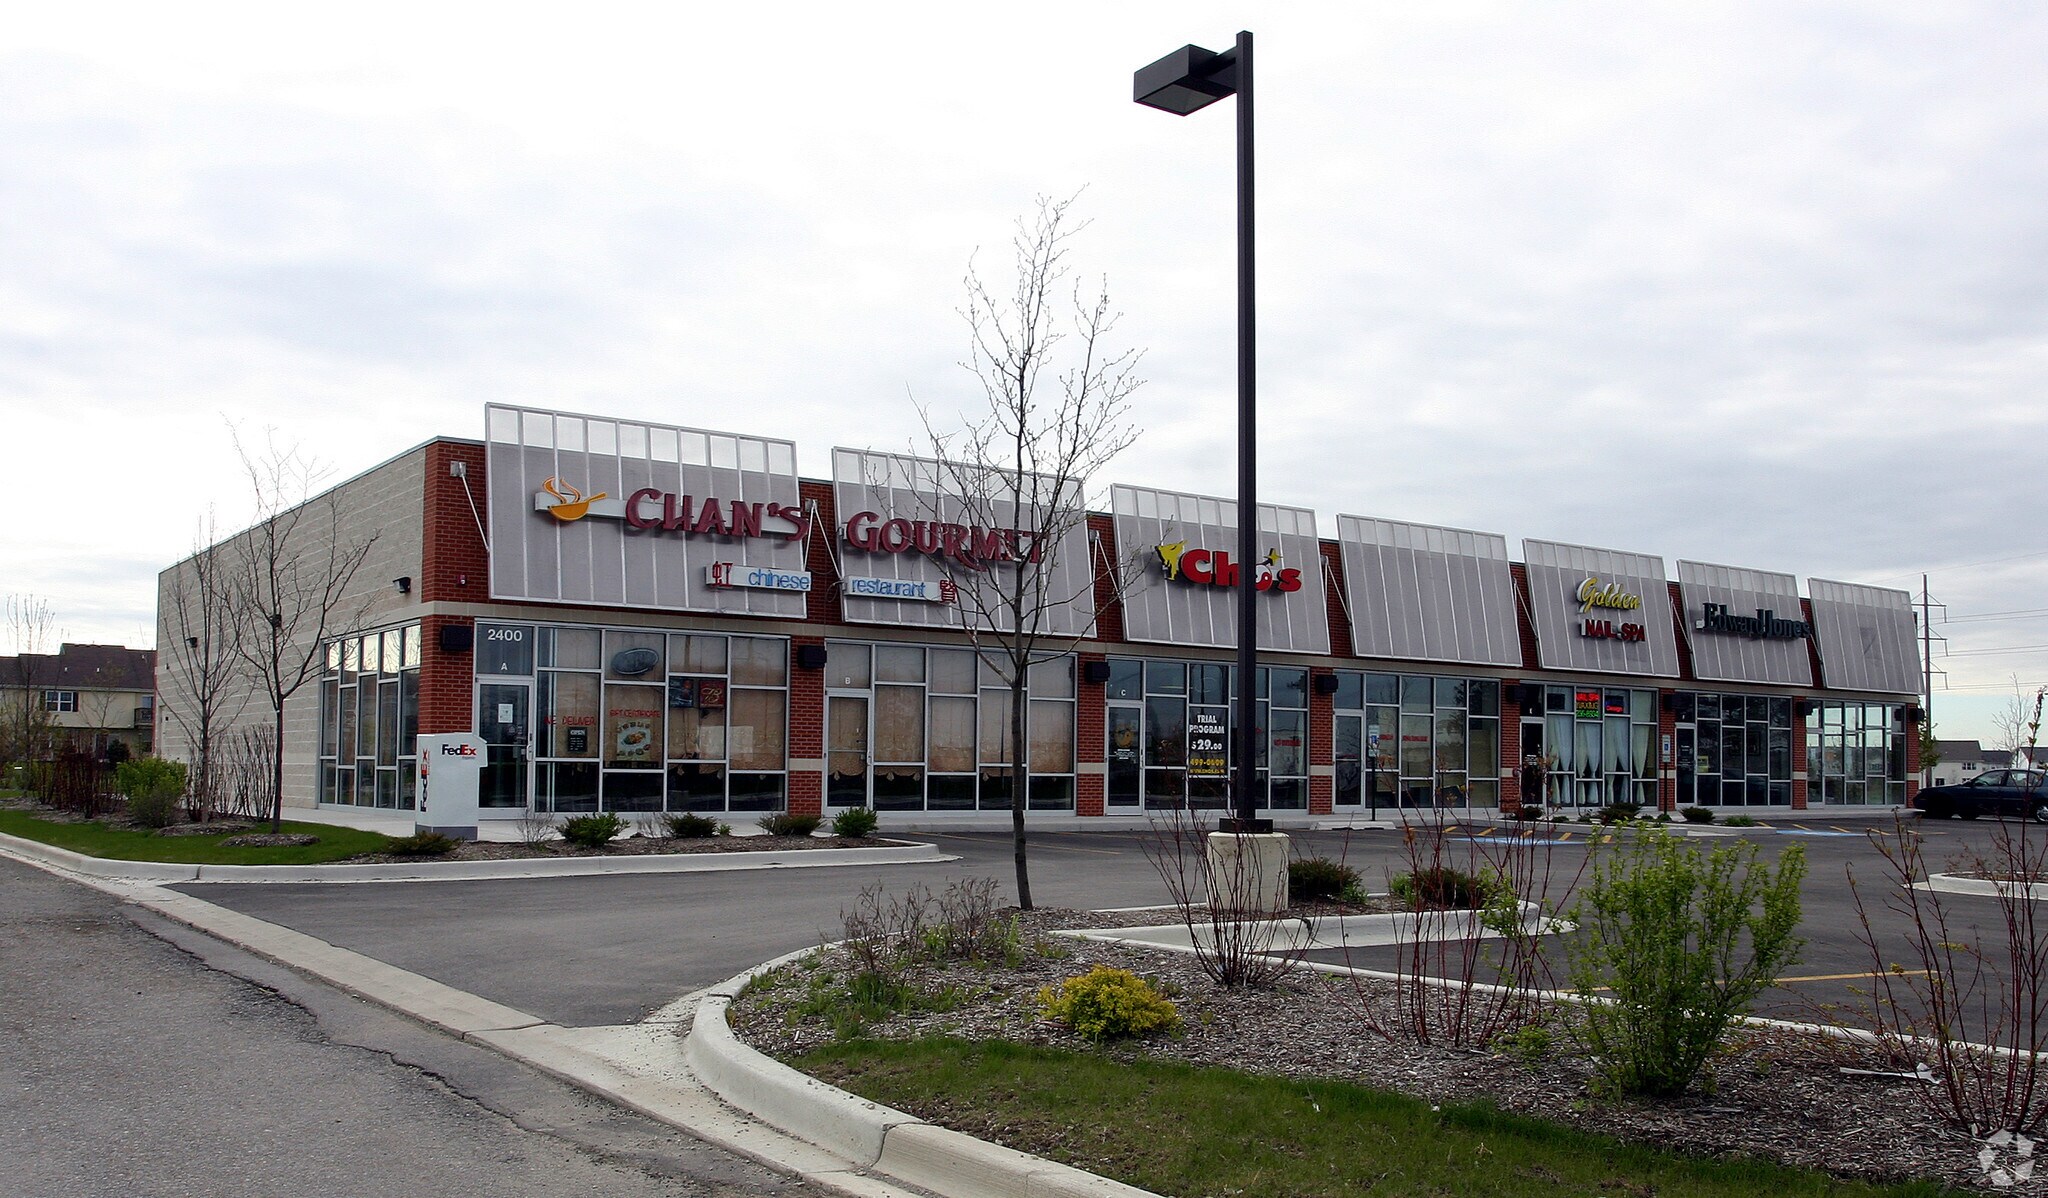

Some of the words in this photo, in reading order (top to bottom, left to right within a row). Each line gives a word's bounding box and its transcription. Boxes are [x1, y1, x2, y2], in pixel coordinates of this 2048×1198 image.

[625, 488, 809, 541] CHAN'S
[748, 569, 810, 590] chinese
[851, 575, 926, 598] restaurant
[1577, 577, 1640, 614] Golden
[487, 628, 523, 642] 2400
[1582, 619, 1617, 639] NAIL
[1619, 622, 1646, 642] SPA
[500, 662, 508, 671] A
[844, 676, 851, 685] B
[1120, 689, 1127, 697] C
[562, 716, 596, 726] DELIVER
[1197, 715, 1217, 723] TRIAL
[1189, 725, 1225, 734] PROGRAM
[441, 743, 477, 757] FedEx
[420, 749, 428, 812] FedEx
